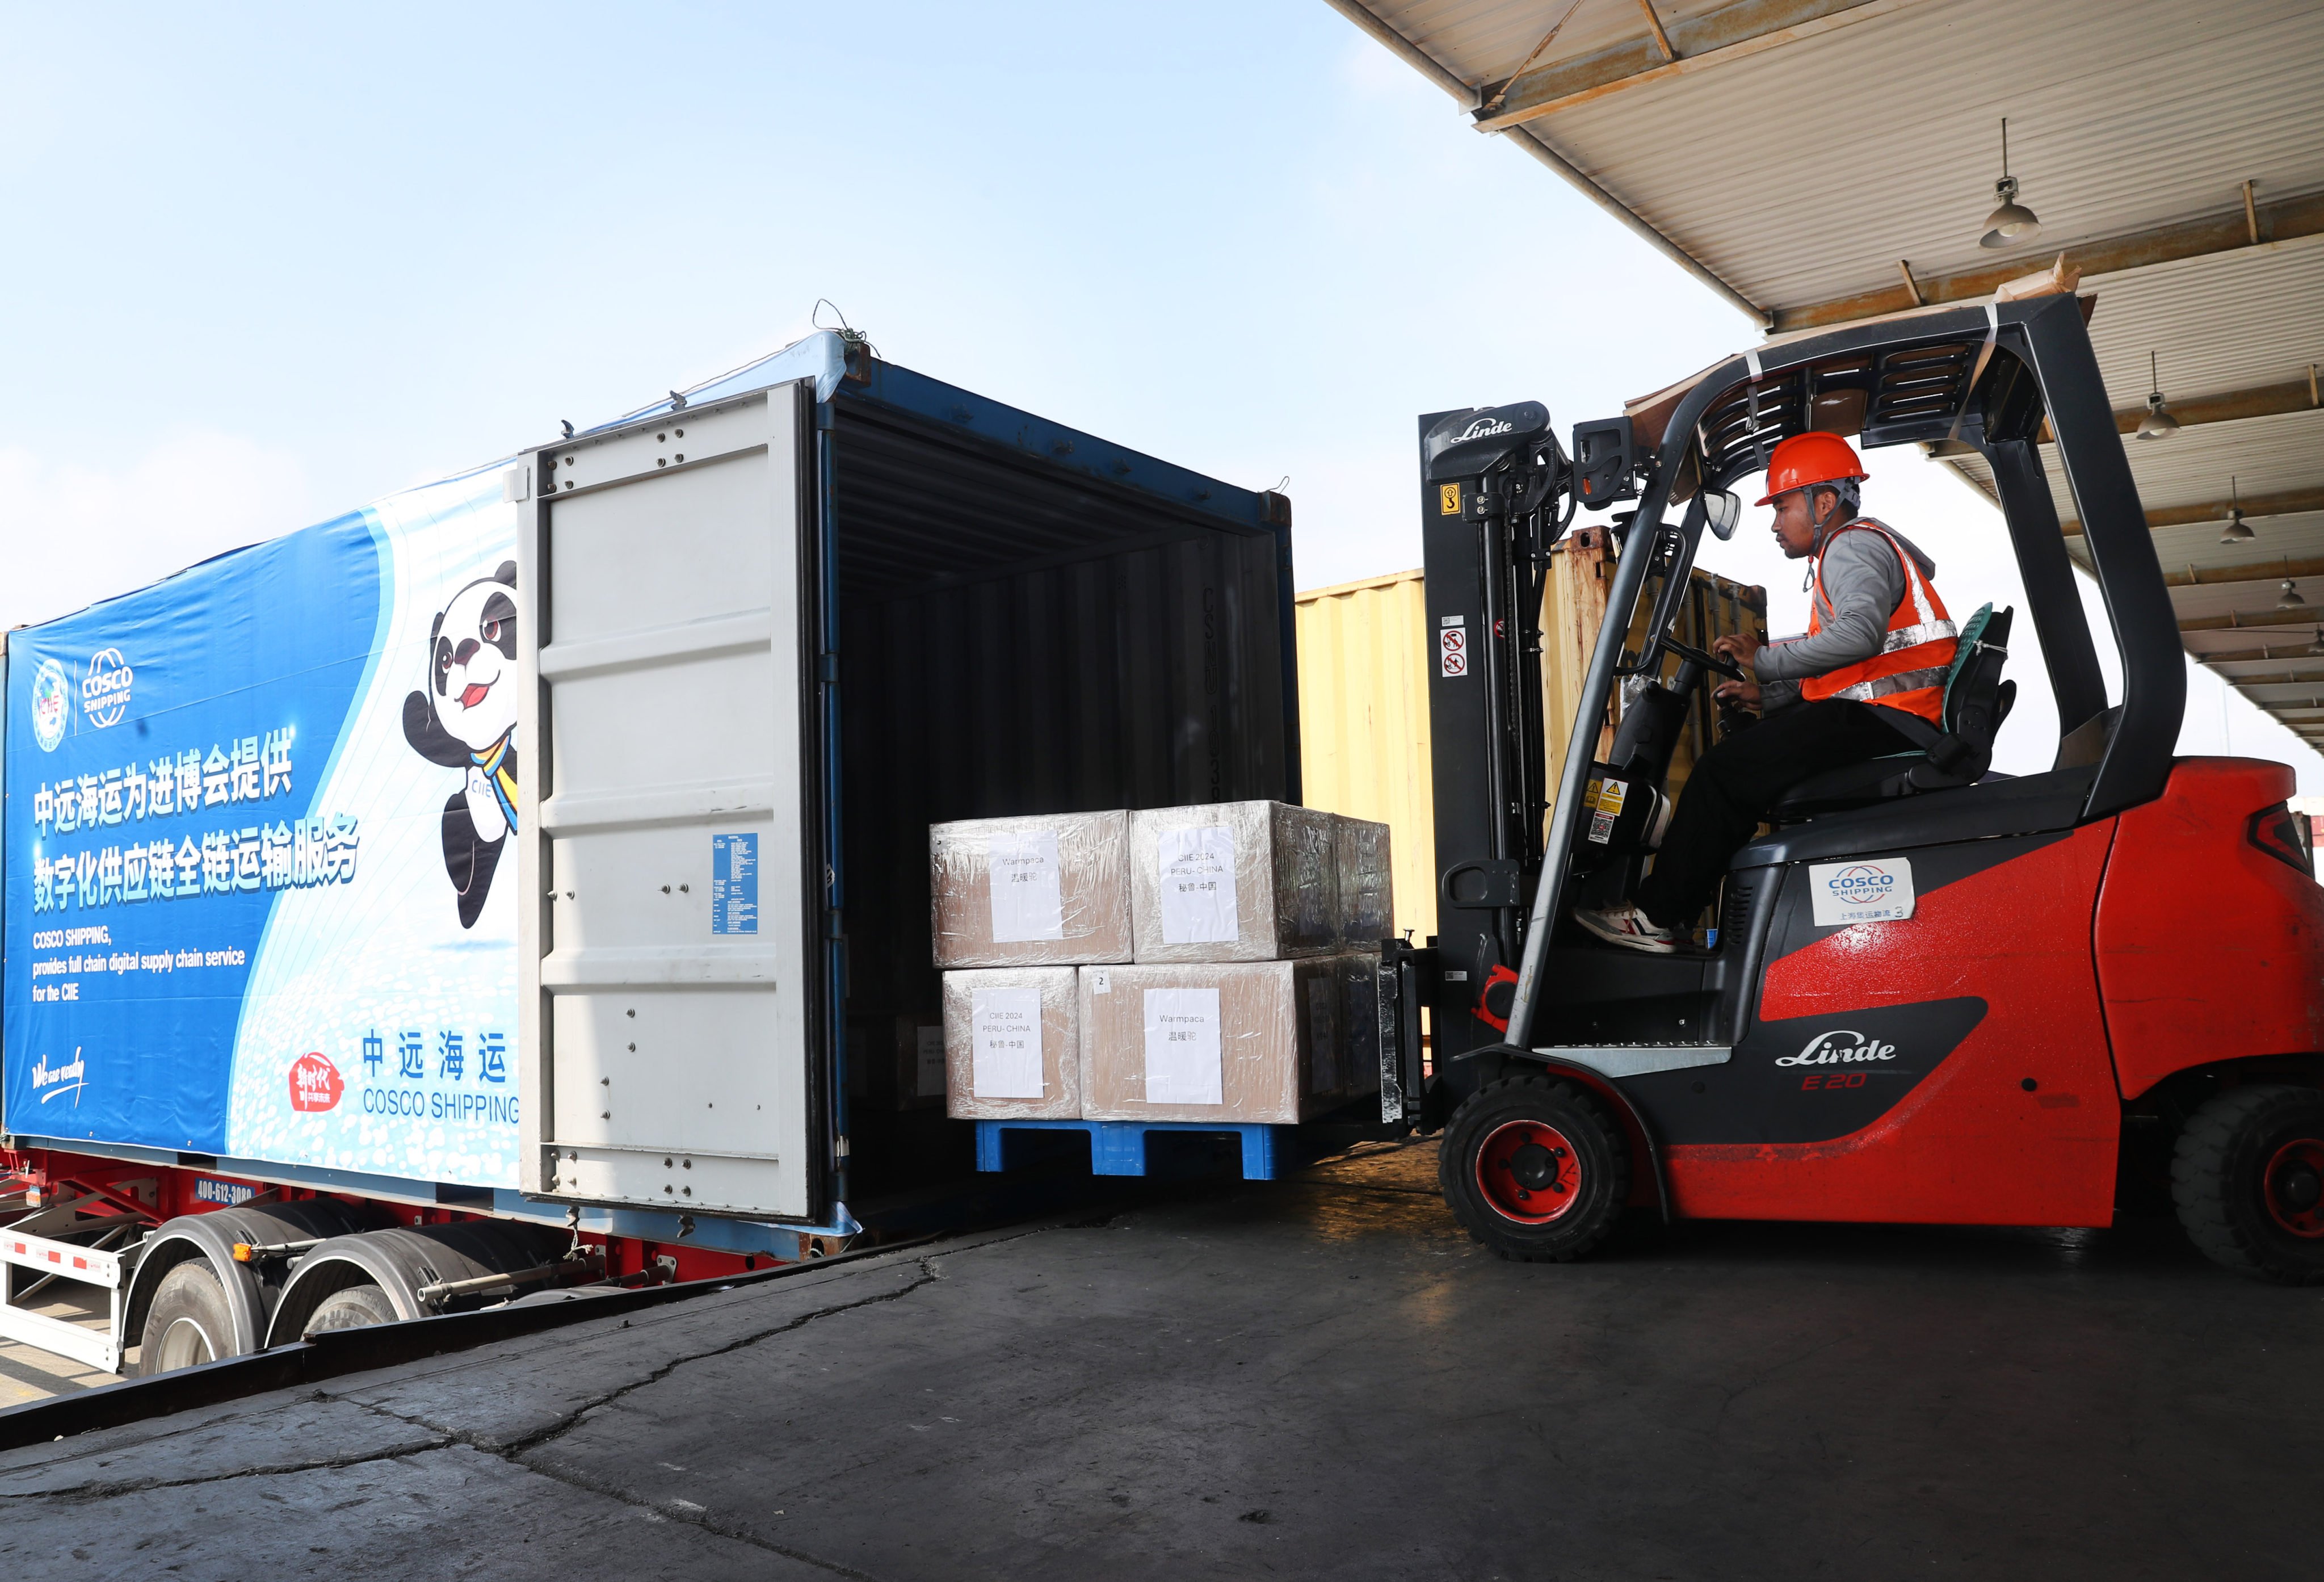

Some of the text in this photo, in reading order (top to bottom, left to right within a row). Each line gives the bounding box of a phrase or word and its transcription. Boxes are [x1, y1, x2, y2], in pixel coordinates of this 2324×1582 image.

[1451, 418, 1512, 443] Linde
[82, 666, 133, 698] COSCO
[84, 689, 131, 714] SHIPPING
[33, 727, 292, 838] 中远海运为进博会提供
[472, 779, 492, 798] CIIE
[33, 812, 359, 913] 数字化供应链全链运输服务
[1002, 857, 1044, 866] Warmpaca
[1178, 853, 1193, 862] CIIE
[1011, 872, 1037, 883] 温暖驼
[1829, 875, 1894, 889] COSCO
[1833, 886, 1892, 896] SHIPPING
[1894, 906, 1903, 918] 3
[33, 925, 112, 950] COSCO SHIPPING,
[32, 946, 245, 980] provides full chain digital supply chain service
[1099, 977, 1104, 985] 2
[32, 983, 79, 1002] for the CIIE
[1159, 1015, 1204, 1024] Warmpaca
[1168, 1031, 1196, 1041] 温暖驼
[363, 1029, 506, 1083] 中远海运
[1775, 1030, 1896, 1067] Linde
[32, 1046, 85, 1109] We are ready
[296, 1063, 330, 1110] 新时代
[1801, 1073, 1867, 1090] E 20
[363, 1088, 519, 1124] COSCO SHIPPING
